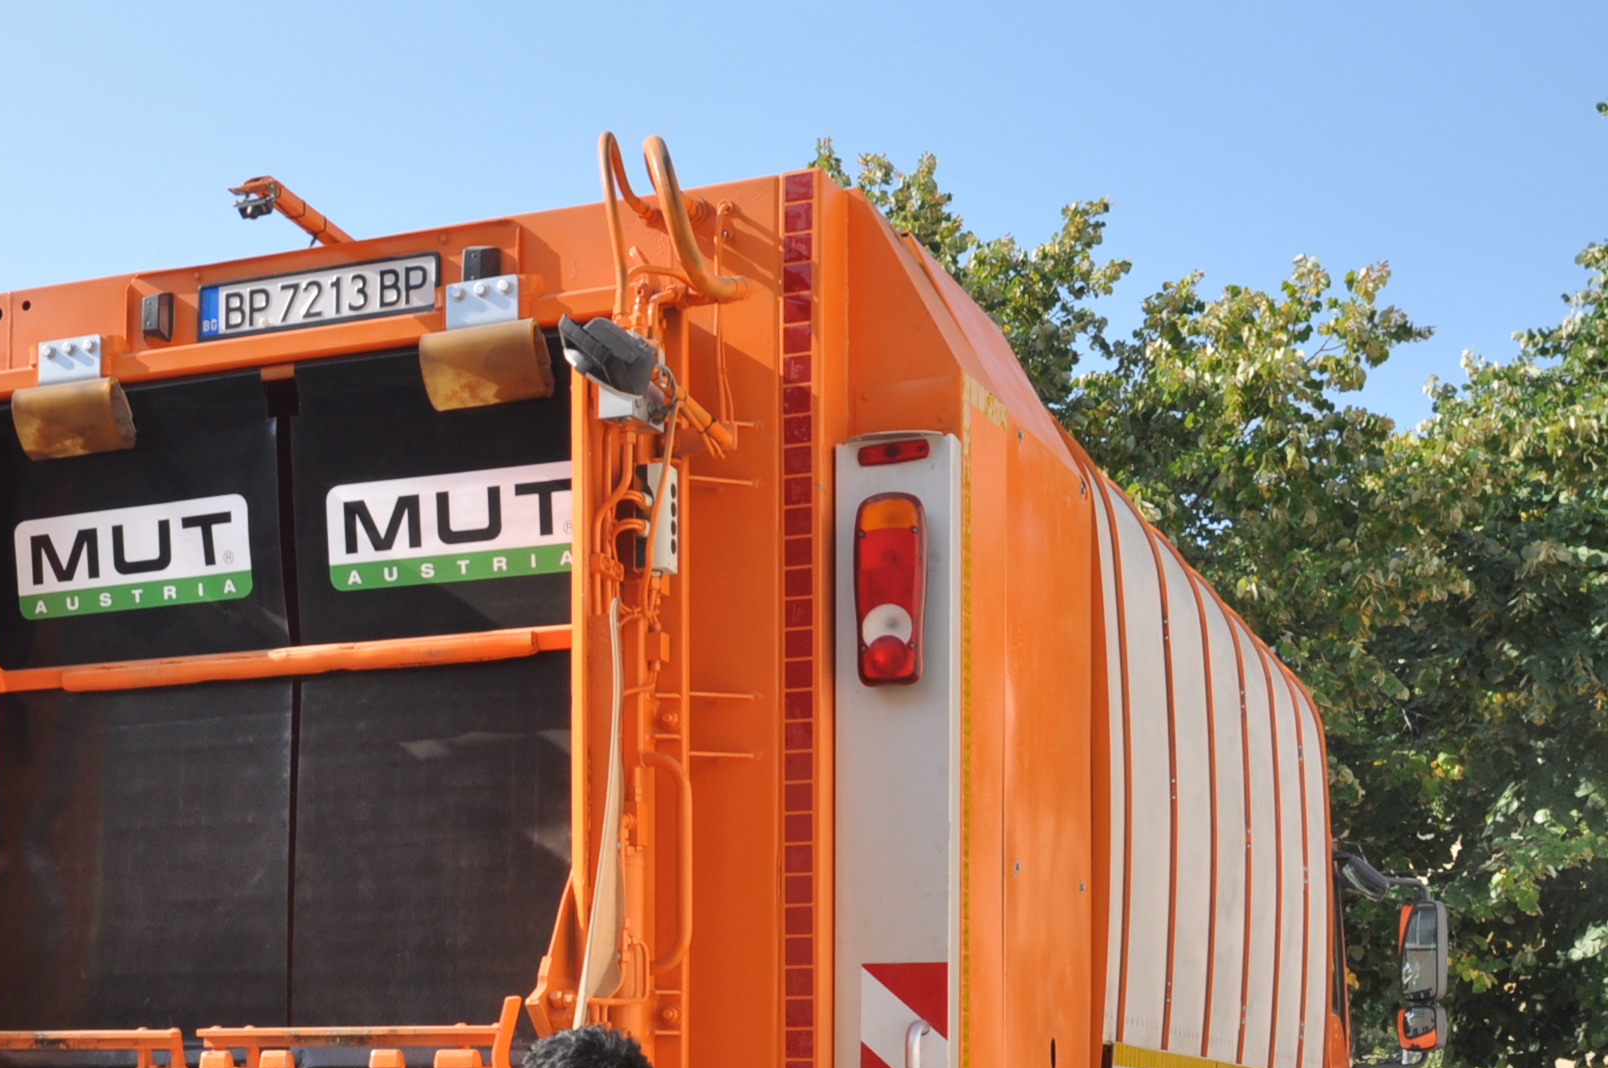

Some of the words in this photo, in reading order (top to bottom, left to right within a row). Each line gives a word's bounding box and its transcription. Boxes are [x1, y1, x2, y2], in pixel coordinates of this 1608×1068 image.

[280, 274, 368, 323] 7213
[202, 319, 218, 332] BG
[343, 478, 573, 554] MUT
[30, 511, 232, 585] MUT
[347, 550, 573, 585] AUSTRIA
[34, 579, 237, 614] AUSTRIA
